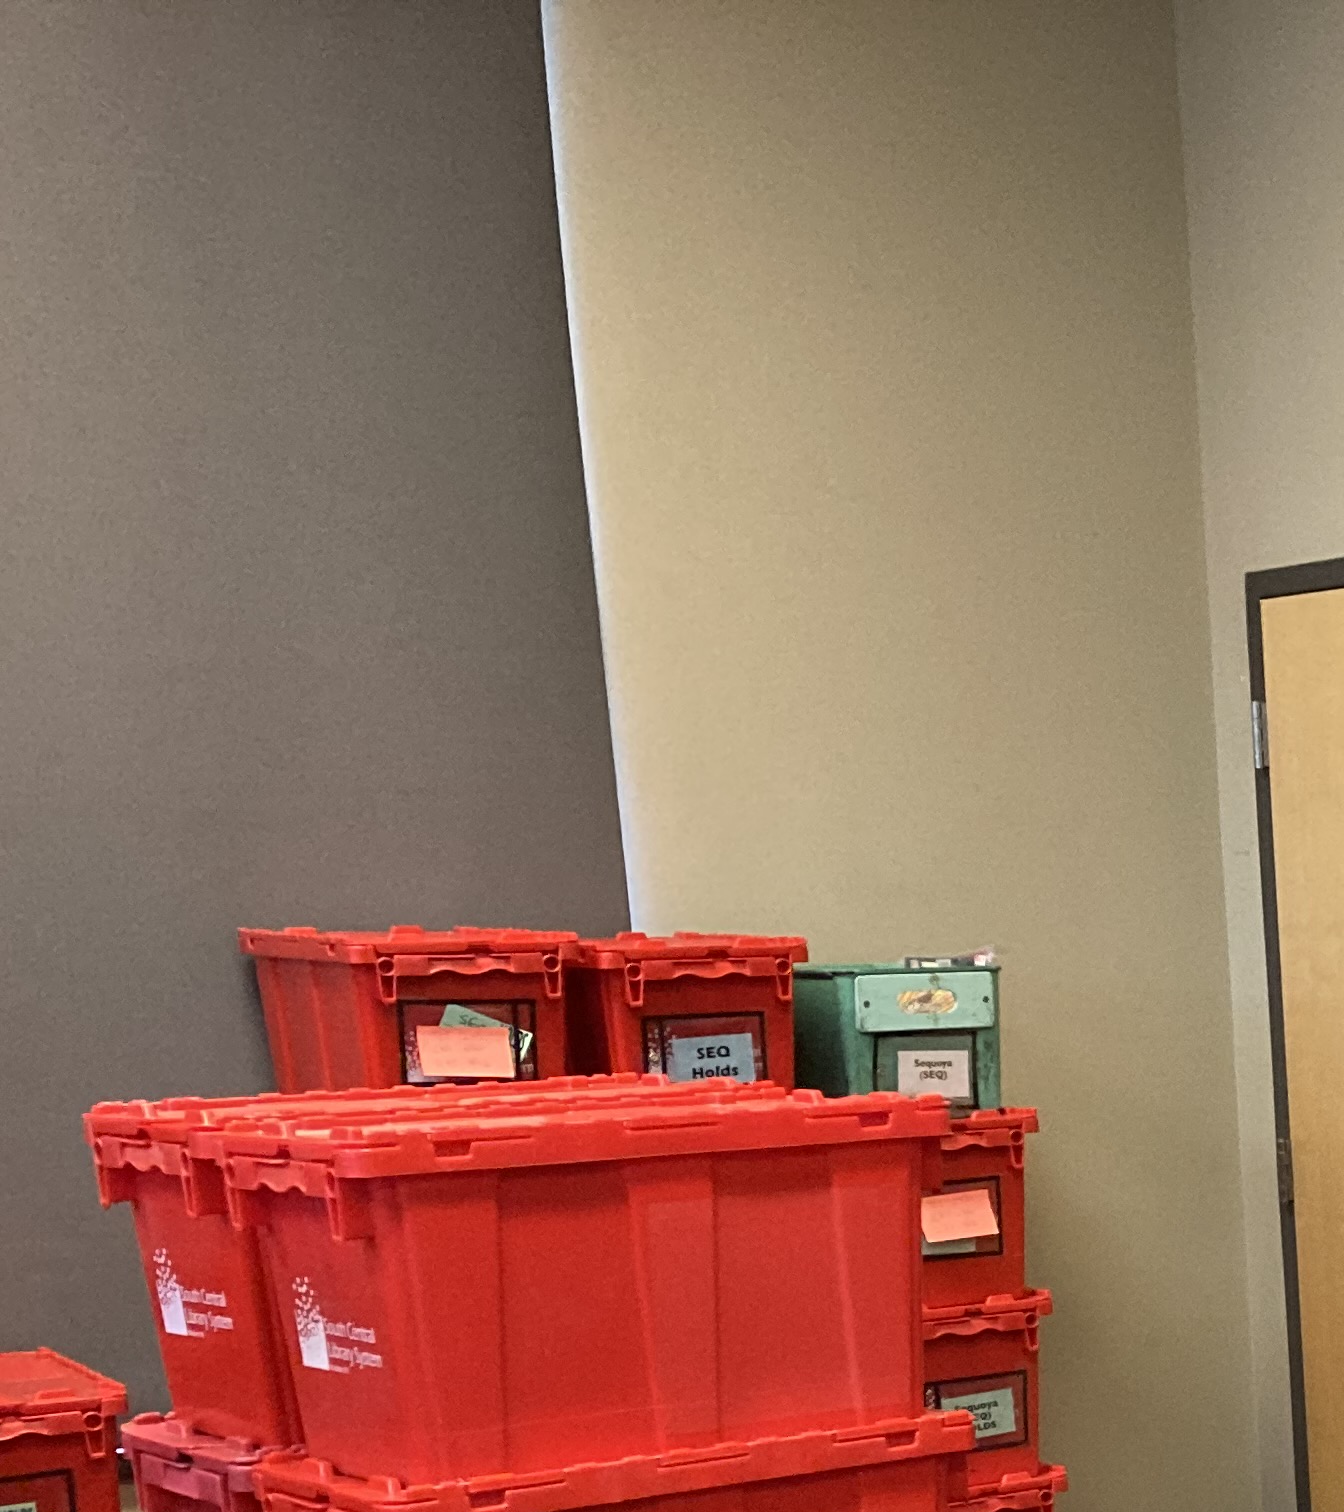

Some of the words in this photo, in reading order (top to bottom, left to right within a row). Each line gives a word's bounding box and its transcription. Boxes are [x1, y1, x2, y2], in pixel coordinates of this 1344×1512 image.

[696, 1045, 731, 1060] SEQ
[914, 1058, 953, 1070] Sequoya
[691, 1064, 740, 1079] Holds
[919, 1069, 948, 1081] (SEQ)
